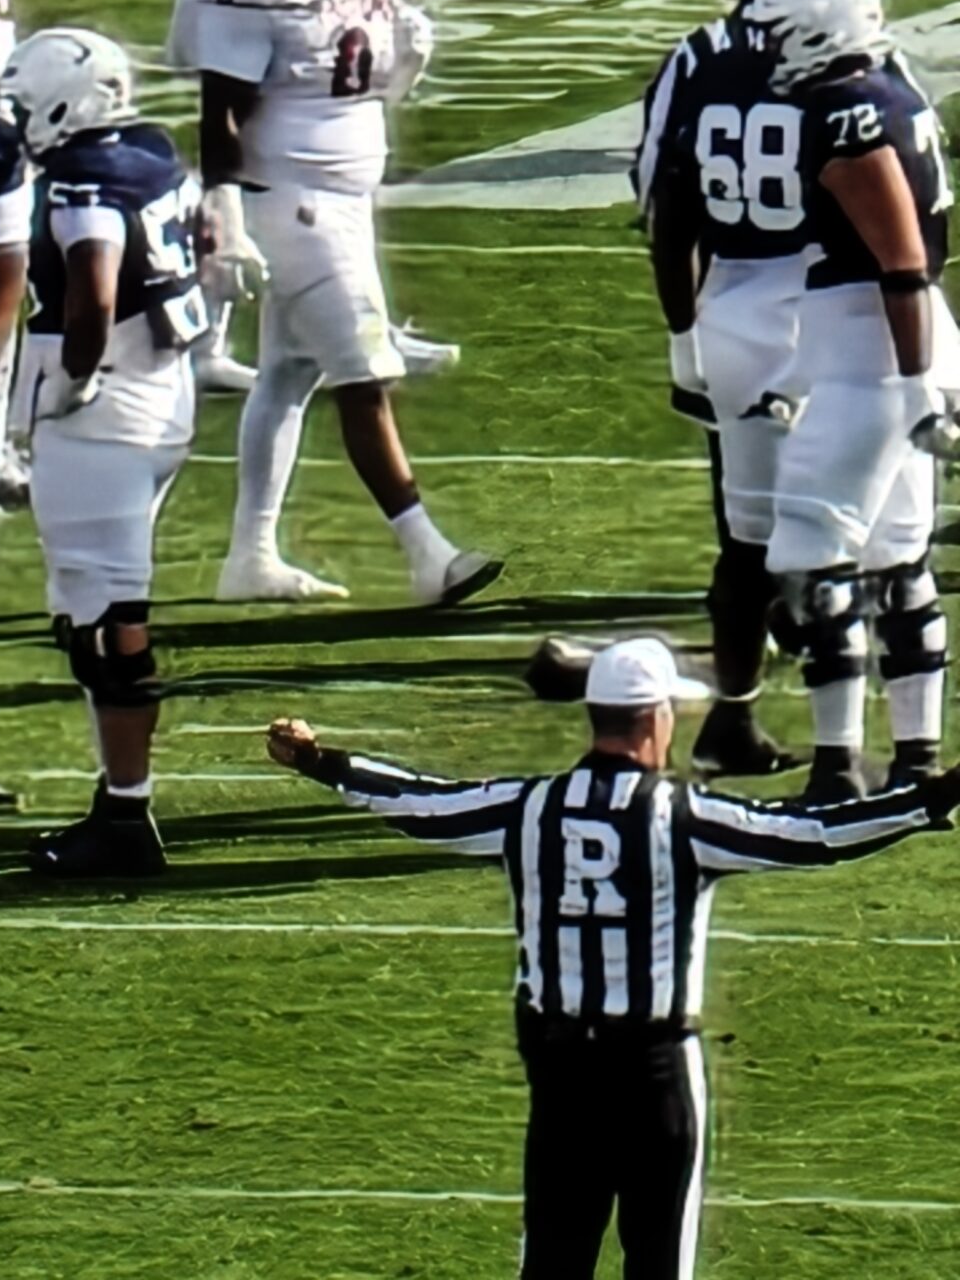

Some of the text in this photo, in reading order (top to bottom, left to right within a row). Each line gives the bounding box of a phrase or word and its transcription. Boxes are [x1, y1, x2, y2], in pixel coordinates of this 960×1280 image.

[695, 102, 806, 231] 68
[826, 103, 884, 147] 72
[558, 817, 627, 916] R
